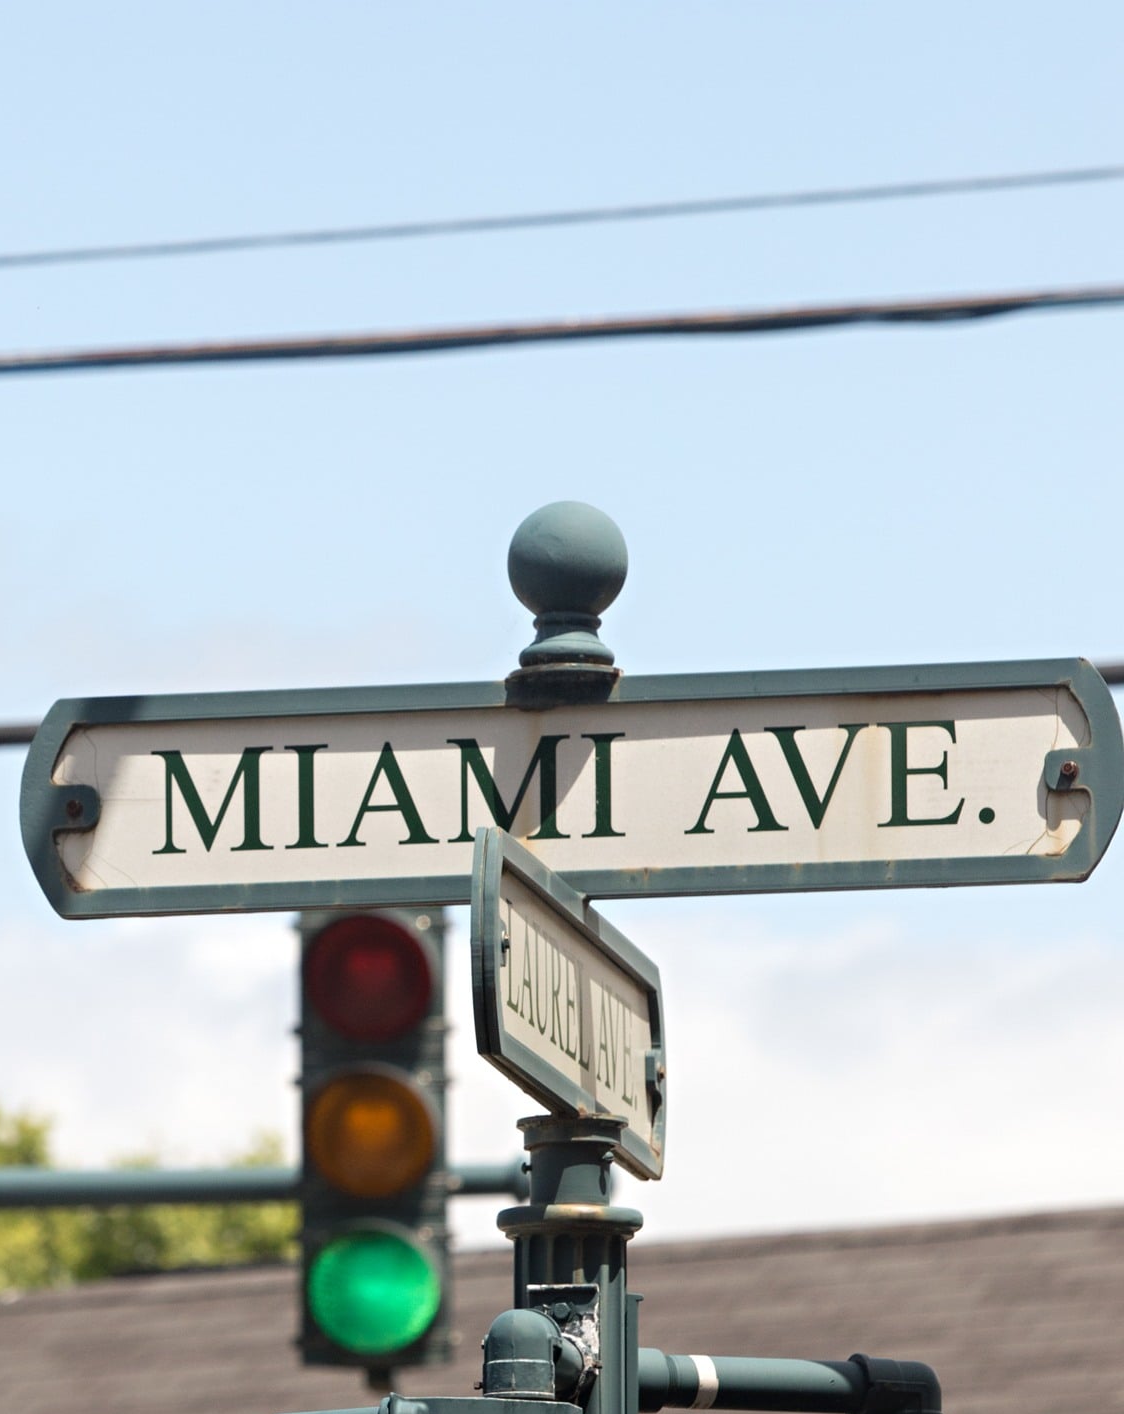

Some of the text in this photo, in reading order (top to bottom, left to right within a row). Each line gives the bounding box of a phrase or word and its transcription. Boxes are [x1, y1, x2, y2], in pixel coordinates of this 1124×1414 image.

[152, 719, 996, 855] MIAMI AVE.
[506, 898, 590, 1072] LAUREL
